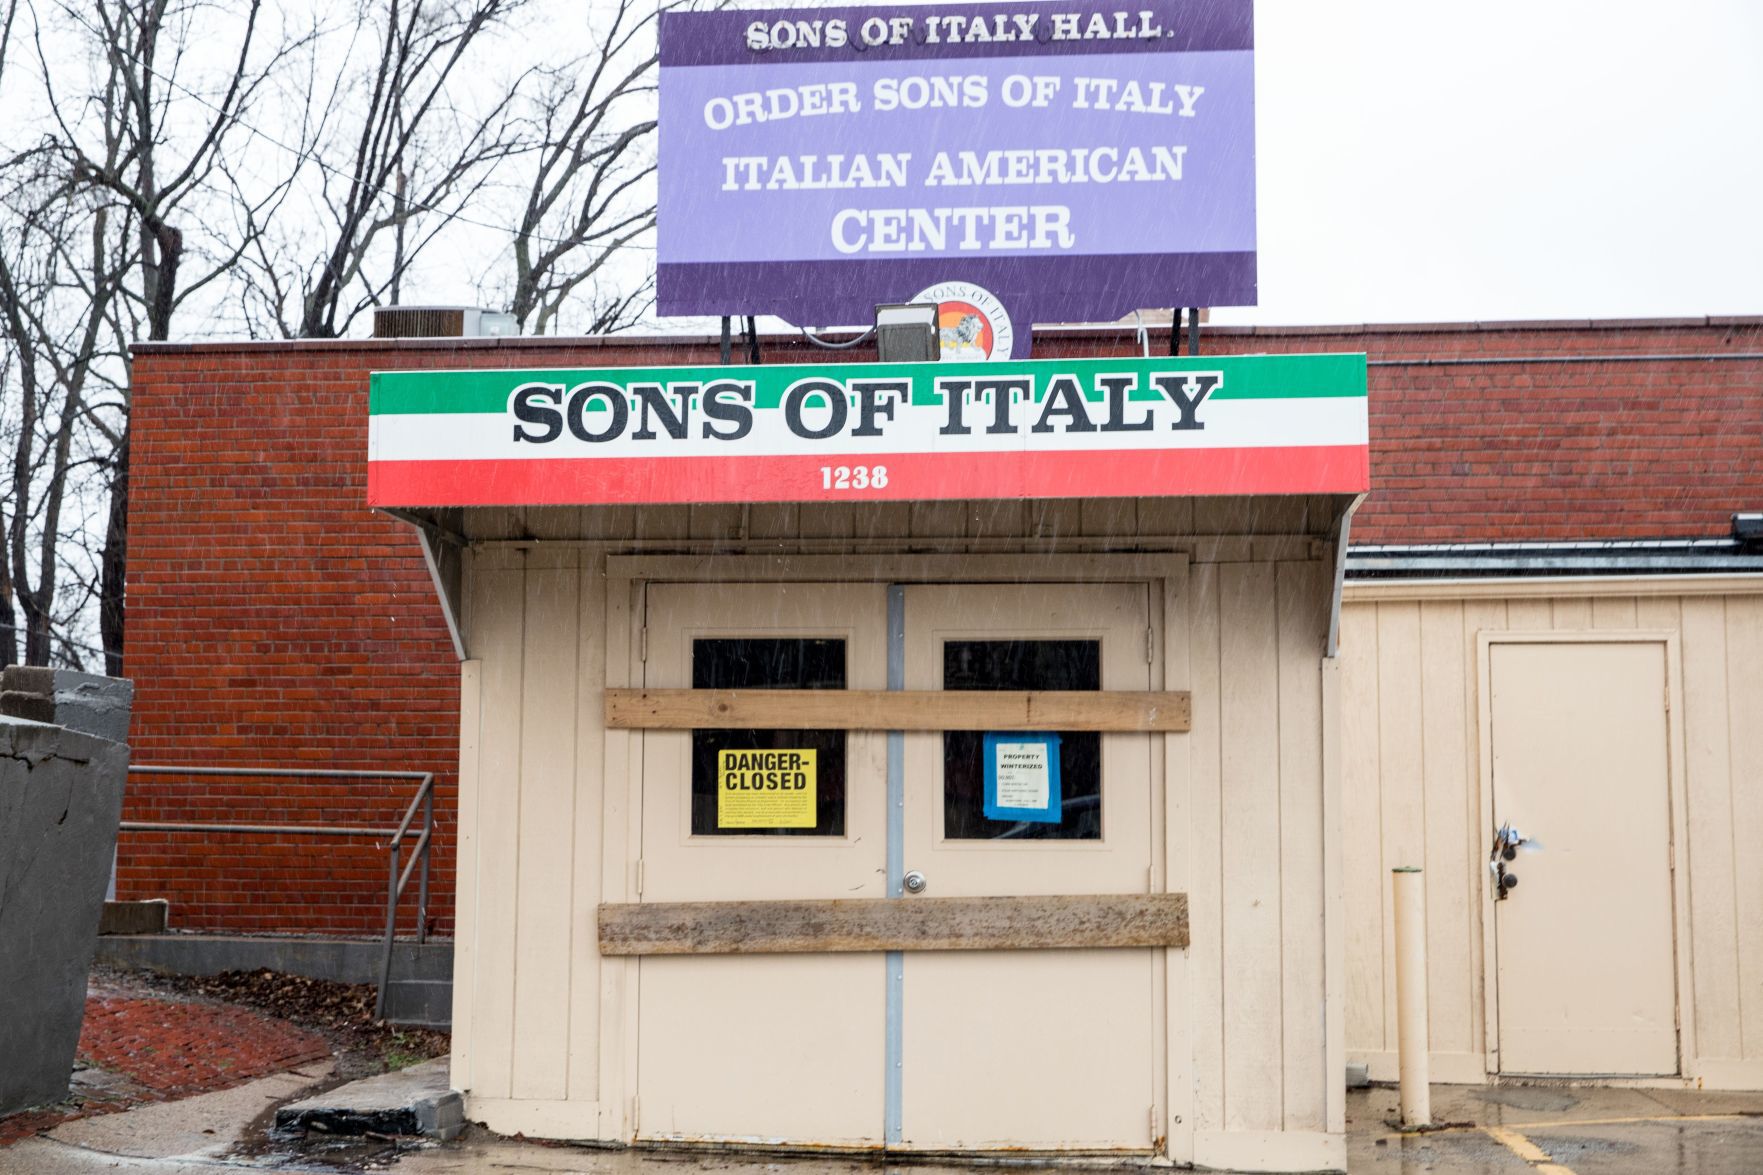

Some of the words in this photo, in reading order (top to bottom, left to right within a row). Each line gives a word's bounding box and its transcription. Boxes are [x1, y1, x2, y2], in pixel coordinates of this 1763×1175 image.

[747, 20, 847, 50] SONS
[860, 17, 912, 46] OF
[926, 14, 1039, 43] ITALY
[704, 82, 860, 130] ORDER
[873, 74, 988, 111] SONS
[1001, 75, 1060, 108] OF
[1072, 77, 1204, 117] ITALY
[722, 154, 911, 191] ITALIAN
[925, 146, 1186, 186] AMERICAN
[830, 204, 1075, 255] CENTER
[923, 285, 967, 303] SONS
[971, 290, 990, 306] OF
[990, 306, 1010, 353] ITALY
[513, 384, 754, 444] SONS
[784, 381, 909, 438] OF
[938, 375, 1219, 436] ITALY
[821, 466, 888, 490] 1238
[725, 753, 809, 770] DANGER-
[725, 772, 806, 790] CLOSED
